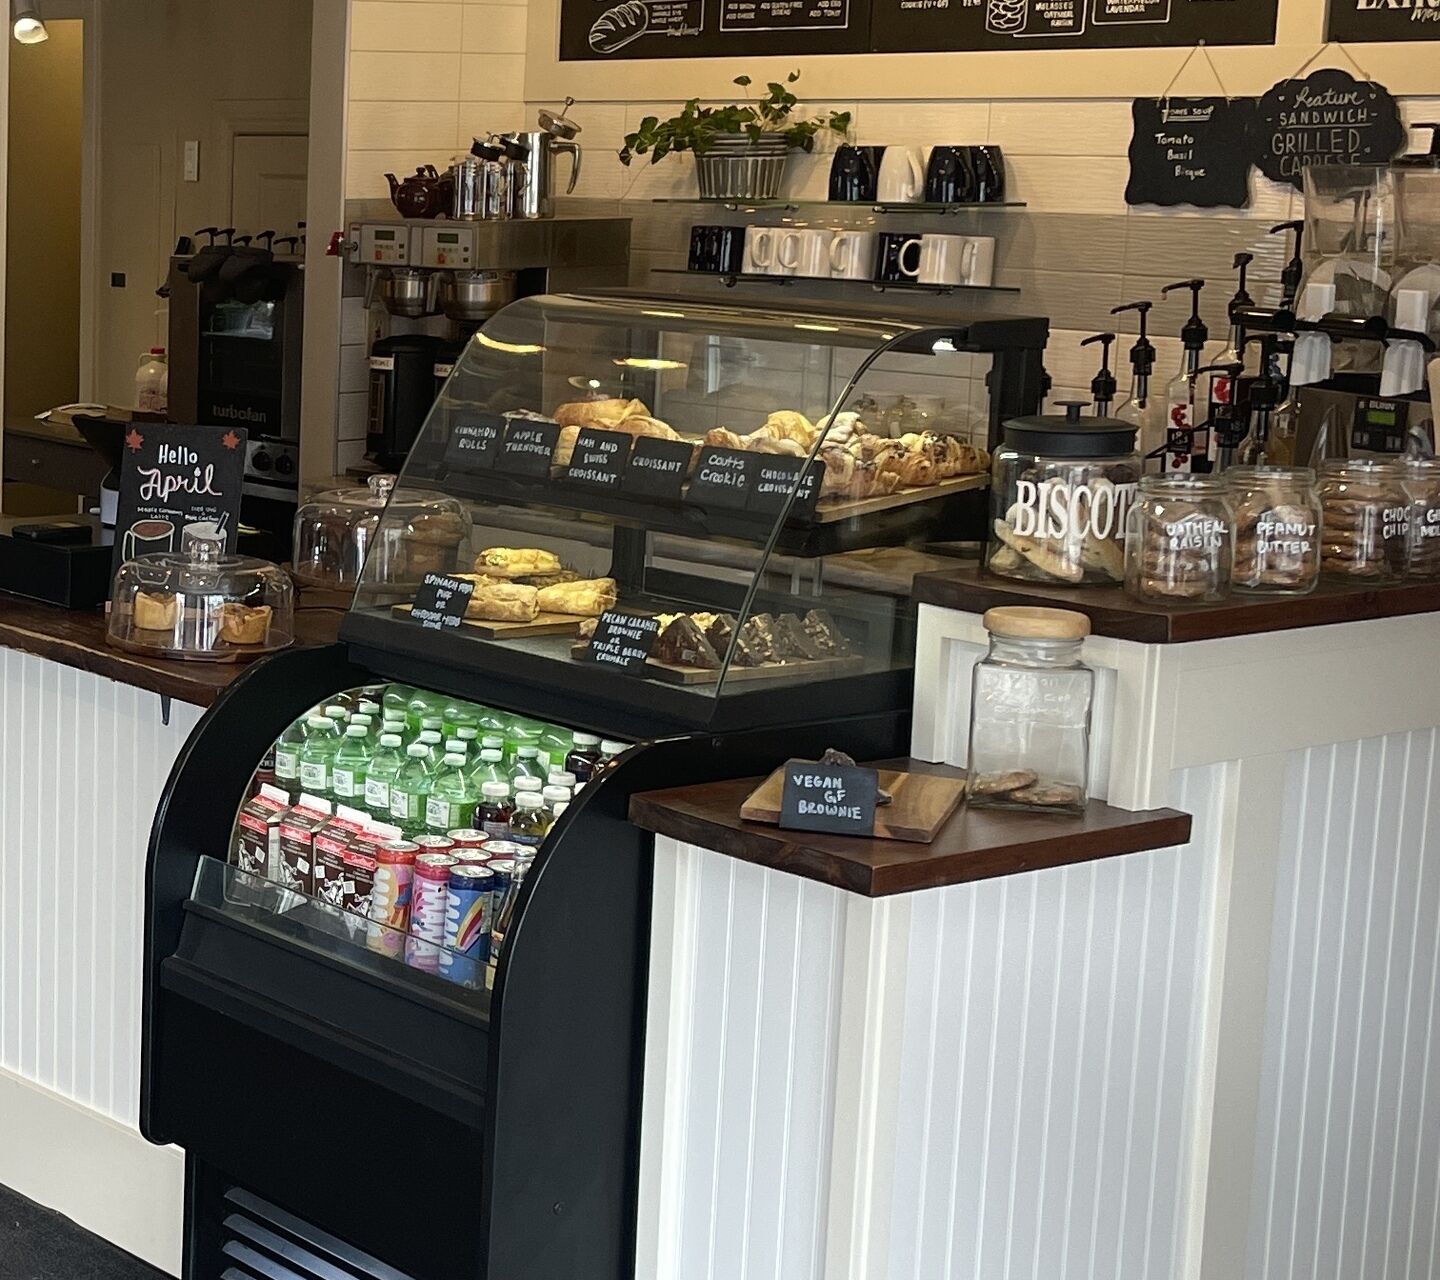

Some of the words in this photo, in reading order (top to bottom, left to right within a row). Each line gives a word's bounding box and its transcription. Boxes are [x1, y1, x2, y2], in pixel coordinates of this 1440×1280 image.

[1035, 2, 1074, 11] MOLASSES
[1279, 108, 1368, 126] SANDWICH
[1155, 133, 1194, 146] Tomato
[1271, 129, 1361, 155] GRILLED
[1167, 149, 1193, 160] Basil
[1174, 165, 1207, 180] Bisque
[212, 404, 267, 423] turbofan
[455, 425, 497, 439] CINNAMON
[513, 431, 544, 443] APPLE
[458, 438, 488, 451] ROLLS
[505, 442, 552, 456] TURNOVER
[578, 437, 595, 448] HAM
[600, 442, 618, 453] AND
[158, 443, 199, 466] Hello
[583, 452, 609, 465] SWISS
[707, 453, 745, 469] Coutts
[632, 455, 683, 474] CROISSANT
[137, 463, 223, 503] April
[568, 467, 617, 484] CROISSANT
[1382, 506, 1411, 522] CHOC
[1257, 522, 1316, 537] PEANUT
[1382, 523, 1409, 539] CHIP
[1170, 534, 1222, 550] RAISIN
[1257, 540, 1312, 554] BUTTER
[424, 574, 459, 591] SPINACH
[436, 589, 453, 600] PUFF
[435, 601, 447, 609] OR
[602, 613, 628, 625] PECAN
[627, 617, 658, 632] CARAMEL
[608, 625, 644, 640] BROWNIE
[610, 637, 620, 645] OR
[593, 641, 620, 655] TRIPLE
[621, 647, 647, 660] BERRY
[596, 652, 631, 666] CRUMBLE
[792, 774, 843, 790] VEGAN
[824, 789, 846, 804] GF
[798, 799, 862, 821] BROWNIE
